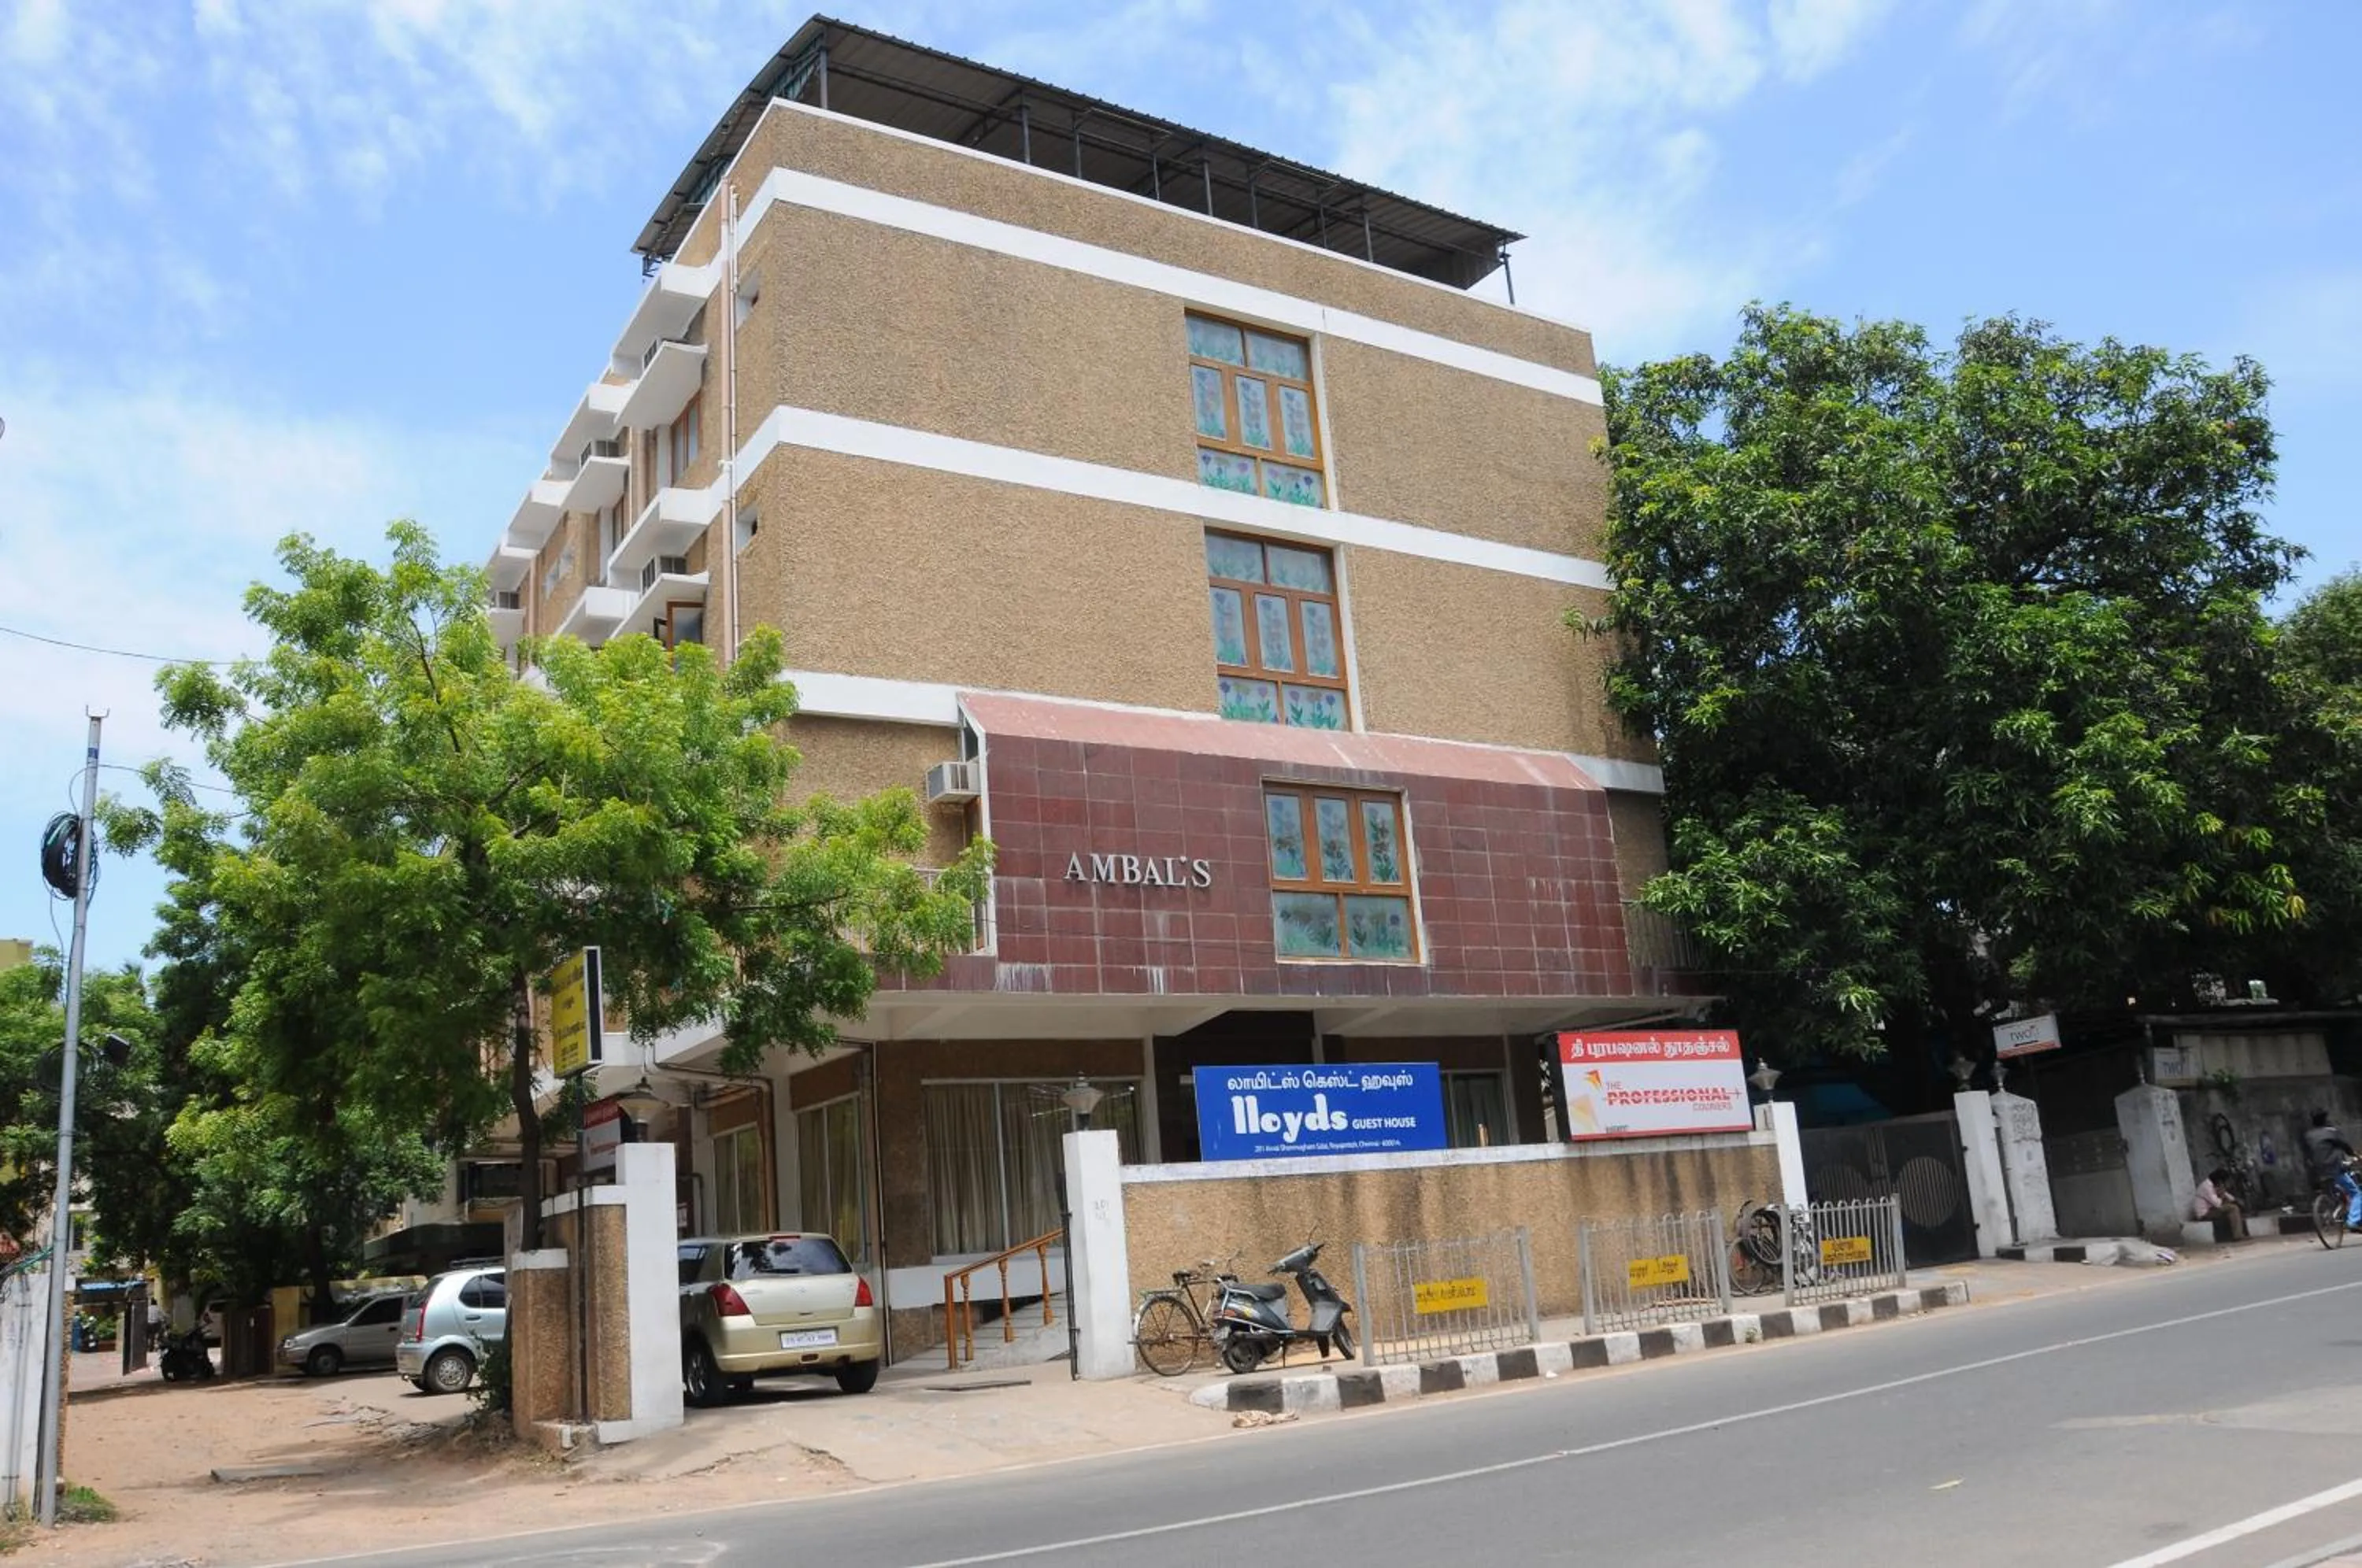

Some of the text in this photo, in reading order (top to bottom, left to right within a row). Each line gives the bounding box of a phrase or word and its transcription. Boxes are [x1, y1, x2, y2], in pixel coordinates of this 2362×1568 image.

[1064, 851, 1212, 888] AMBAL'S
[1227, 1070, 1413, 1092] லாயிட்ஸ் கெஸ்ட் ஹவுஸ்
[1606, 1081, 1622, 1090] THE
[1607, 1087, 1731, 1106] PROFESSIONAL
[1693, 1102, 1733, 1111] COURIERS
[1231, 1093, 1416, 1143] lloyds GUEST HOUSE
